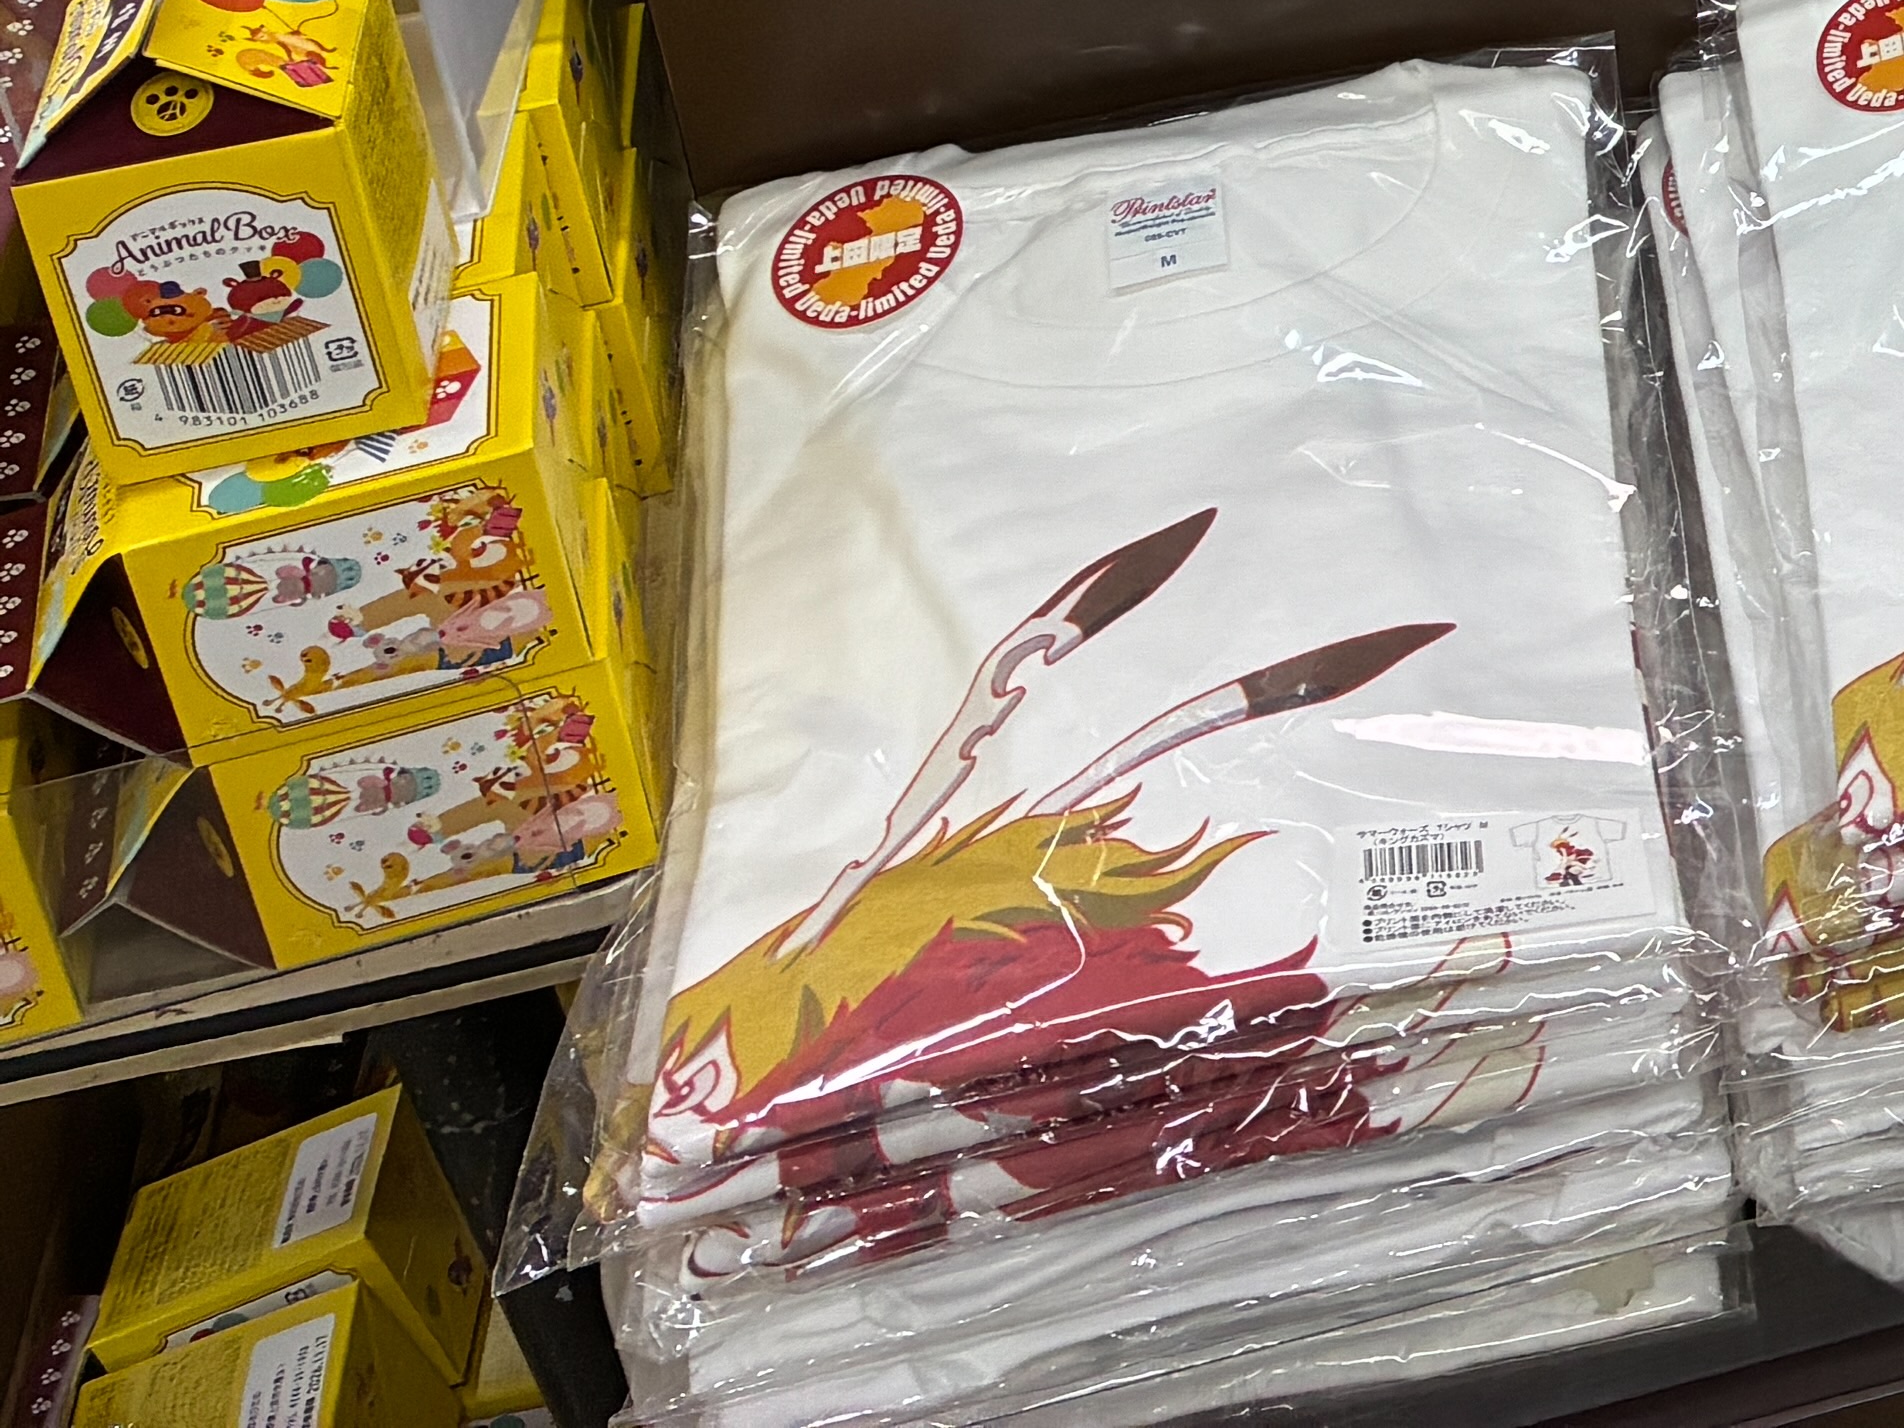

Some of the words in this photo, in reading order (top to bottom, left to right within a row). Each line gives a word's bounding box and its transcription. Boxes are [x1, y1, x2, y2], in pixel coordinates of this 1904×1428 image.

[1111, 188, 1217, 223] Printstar
[111, 217, 224, 275] Animal
[224, 210, 300, 242] Box
[1160, 253, 1177, 268] M
[179, 415, 249, 426] 983101
[258, 390, 320, 422] 103688
